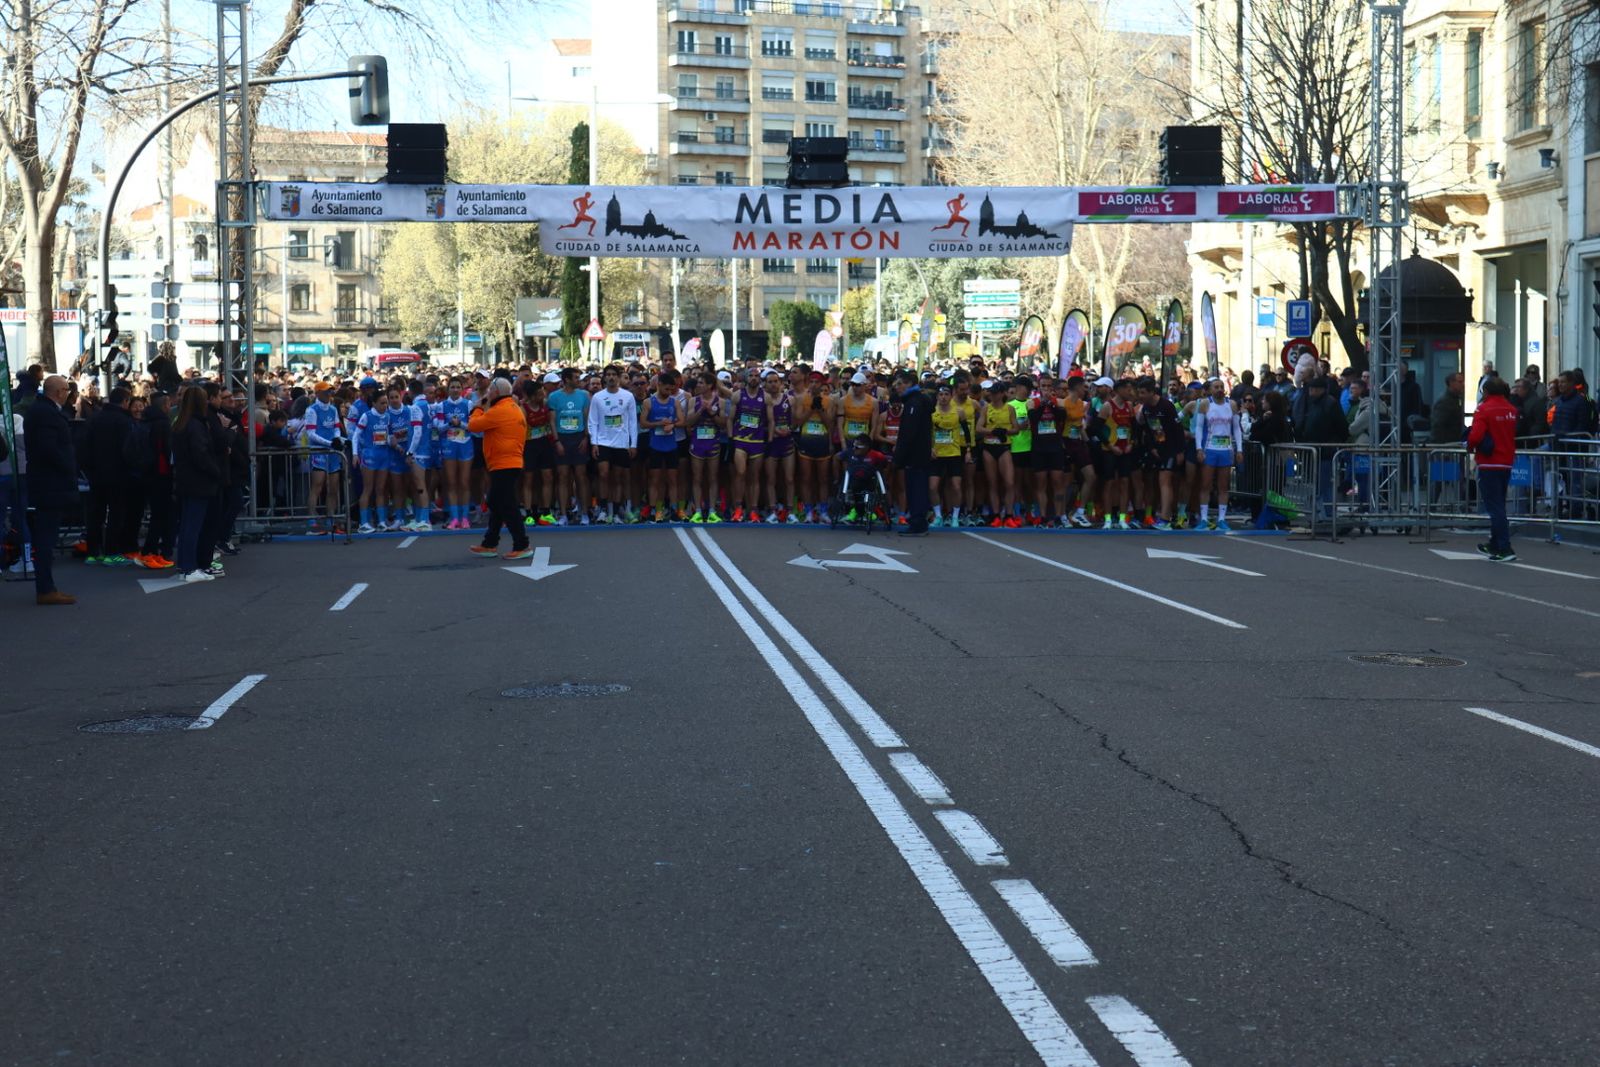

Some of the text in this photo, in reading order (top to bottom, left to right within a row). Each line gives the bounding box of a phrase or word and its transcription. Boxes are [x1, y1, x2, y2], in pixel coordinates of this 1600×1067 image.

[311, 189, 382, 203] Ayuntamiento
[456, 189, 526, 202] Ayuntamiento
[1099, 193, 1159, 205] LABORAL
[1238, 193, 1297, 205] LABORAL
[311, 203, 383, 216] de Salamanca
[456, 203, 527, 216] de Salamanca
[735, 192, 902, 224] MEDIA
[1134, 205, 1160, 214] kutxa
[1273, 205, 1298, 214] kutxa
[732, 226, 900, 251] MARATÓN
[555, 242, 701, 253] CIUDAD DE SALAMANCA
[928, 242, 1071, 252] CIUDAD DE SALAMANCA
